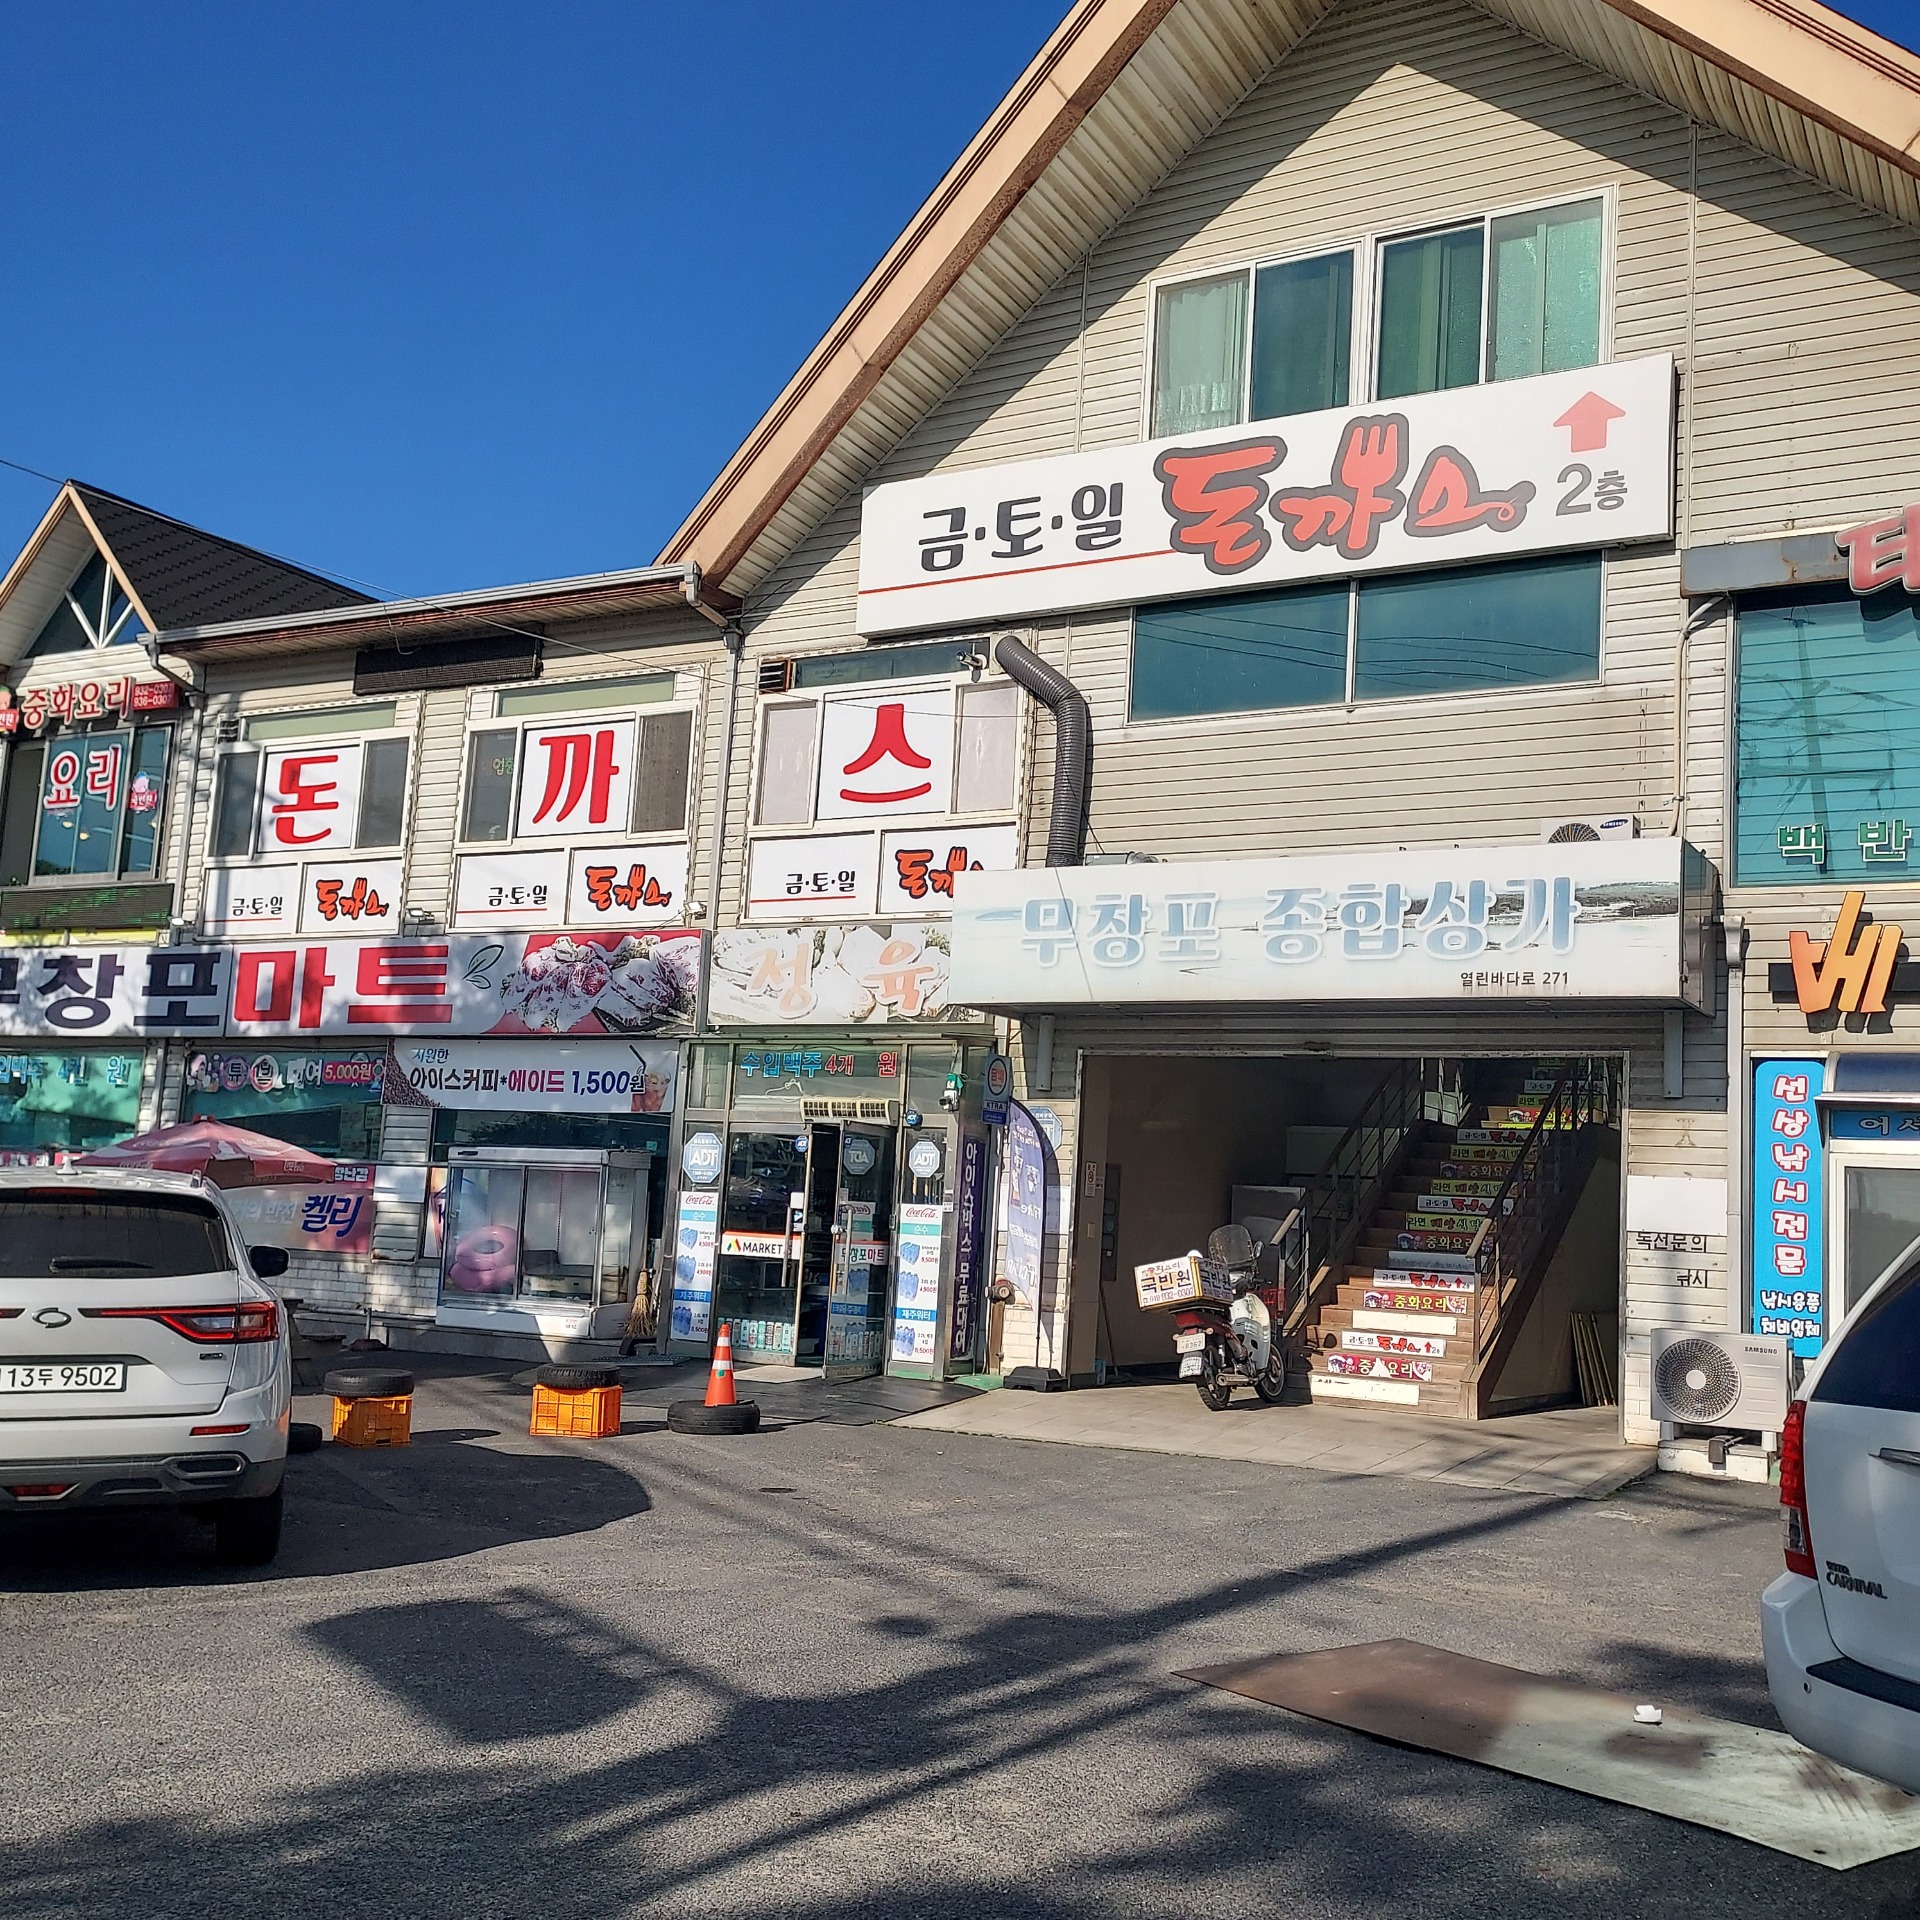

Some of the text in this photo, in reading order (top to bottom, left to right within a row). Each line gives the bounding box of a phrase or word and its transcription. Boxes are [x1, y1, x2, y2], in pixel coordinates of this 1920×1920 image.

[1152, 413, 1536, 576] 돈까스
[1555, 463, 1629, 517] 2층
[21, 676, 132, 730] 중화요리
[840, 703, 932, 803] 스
[43, 744, 122, 811] 요리
[532, 730, 619, 824] 까
[272, 755, 338, 844] 돈
[895, 846, 984, 899] 돈까
[316, 877, 389, 921] 돈까스
[585, 864, 672, 911] 돈까스
[1020, 875, 1582, 969] 무창포 종합상가
[746, 940, 936, 1016] 정육
[1460, 971, 1568, 987] 열린바다로 271
[325, 1063, 371, 1080] 5,000원
[740, 1051, 898, 1078] 수입맥주 4개 원
[571, 1070, 646, 1096] 1,500원
[689, 1148, 718, 1167] ADT
[913, 1153, 936, 1166] ADT
[1772, 1074, 1809, 1276] 선상낚시전문
[301, 1194, 365, 1238] 켈리
[906, 1207, 938, 1218] Coca-Cola
[1407, 1216, 1426, 1228] 라면
[742, 1241, 783, 1255] MARKET
[1140, 1268, 1192, 1293] 국빈원
[1393, 1294, 1447, 1312] 중화요리
[1760, 1290, 1822, 1313] 낚시용품
[901, 1310, 931, 1321] 제주워터
[1744, 1345, 1778, 1355] SAMSUNG
[0, 1366, 117, 1388] 13두 9502
[1358, 1359, 1414, 1378] 중요리
[1826, 1570, 1888, 1600] CARNIVAL
